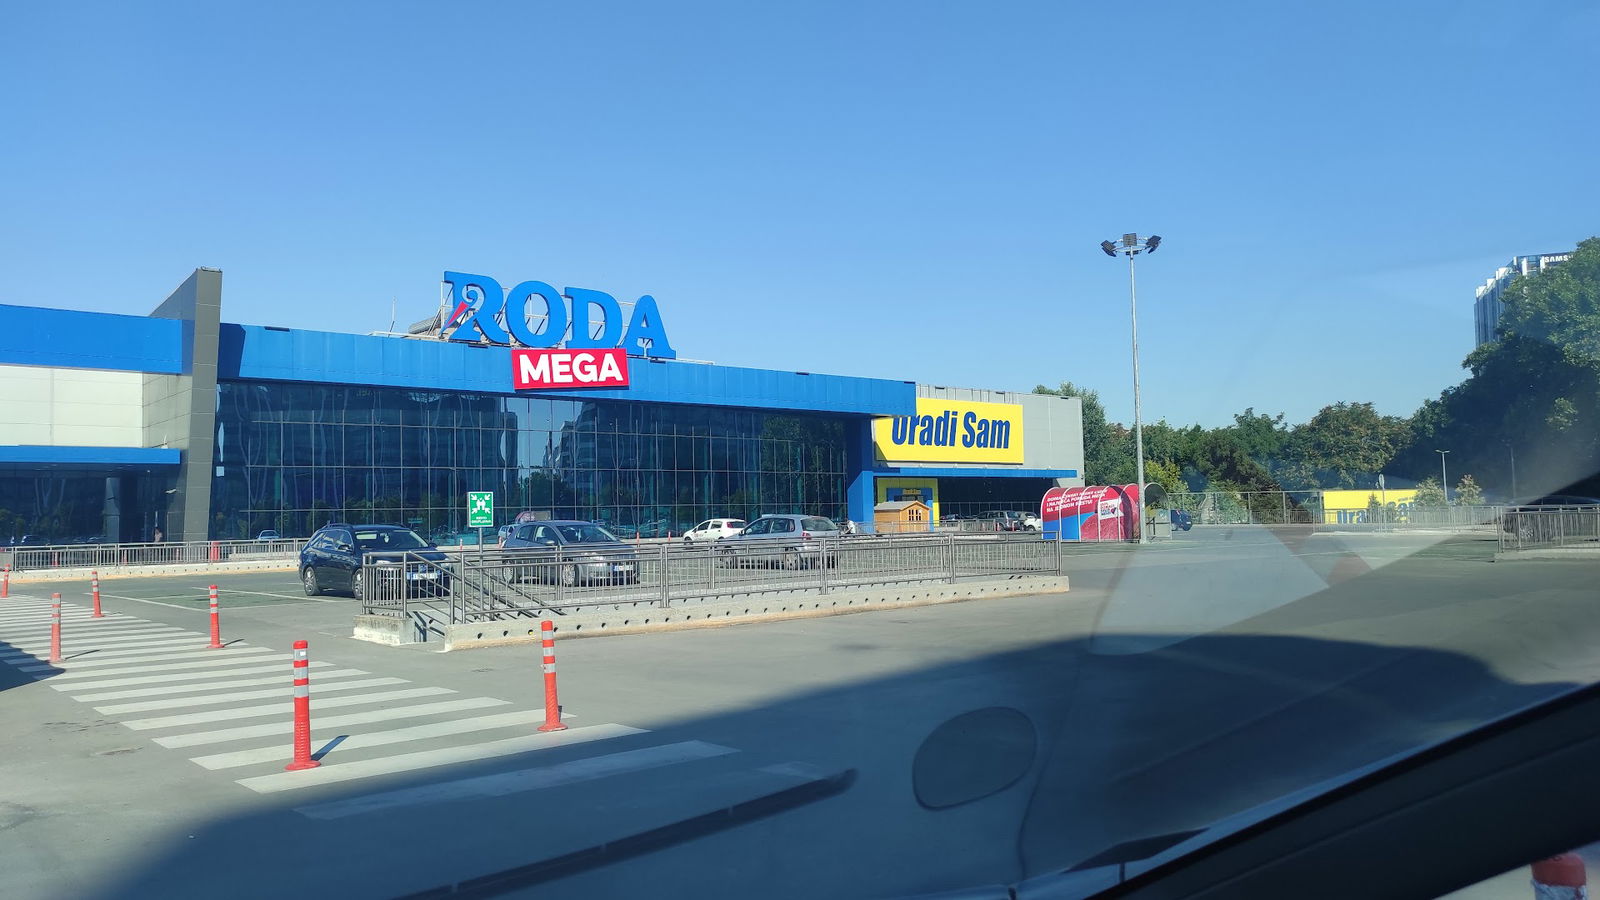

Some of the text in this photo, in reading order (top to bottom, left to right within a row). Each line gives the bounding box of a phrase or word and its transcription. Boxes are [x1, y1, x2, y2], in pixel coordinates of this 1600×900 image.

[440, 271, 676, 360] RODA
[519, 353, 623, 384] MEGA
[962, 411, 1010, 449] Sam
